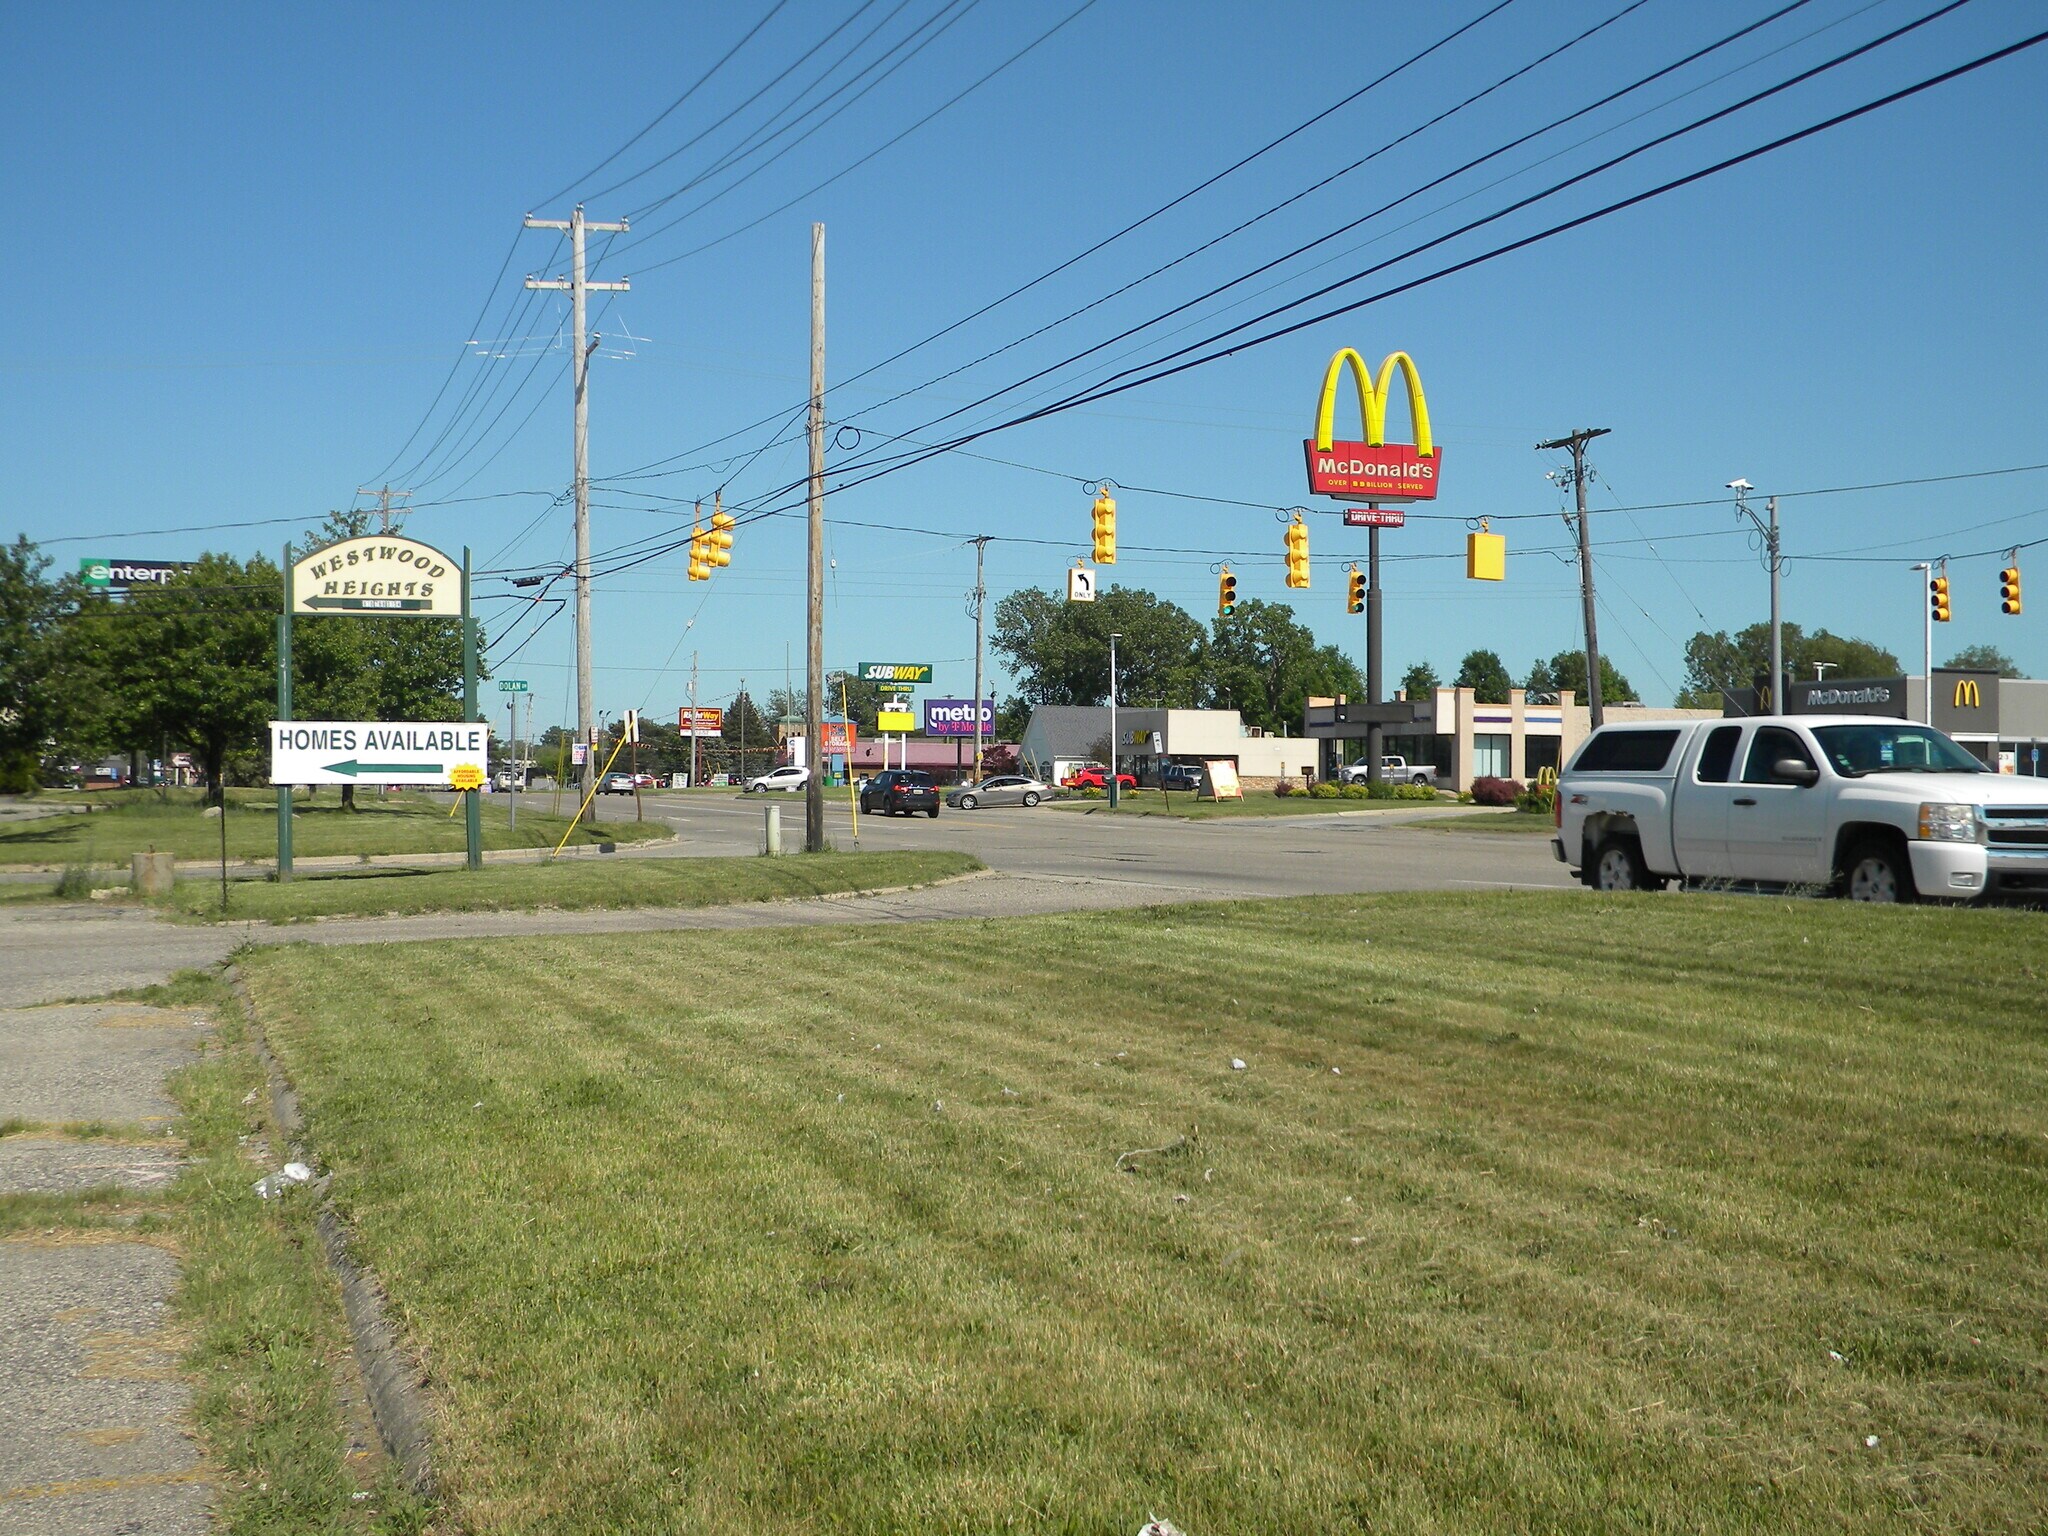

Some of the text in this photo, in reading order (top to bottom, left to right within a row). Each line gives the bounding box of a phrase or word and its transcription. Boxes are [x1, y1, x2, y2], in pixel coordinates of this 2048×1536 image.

[1317, 457, 1434, 479] McDonald's
[1397, 482, 1424, 490] SERVED
[1351, 510, 1404, 523] DRIVE-THRU
[310, 546, 446, 580] WESTWOOD
[323, 580, 434, 597] HEIGHTS
[864, 665, 929, 680] SUBWAY
[499, 681, 521, 690] DOLAN
[1807, 687, 1890, 706] McDonald's
[279, 729, 480, 751] HOMES AVAILABLE
